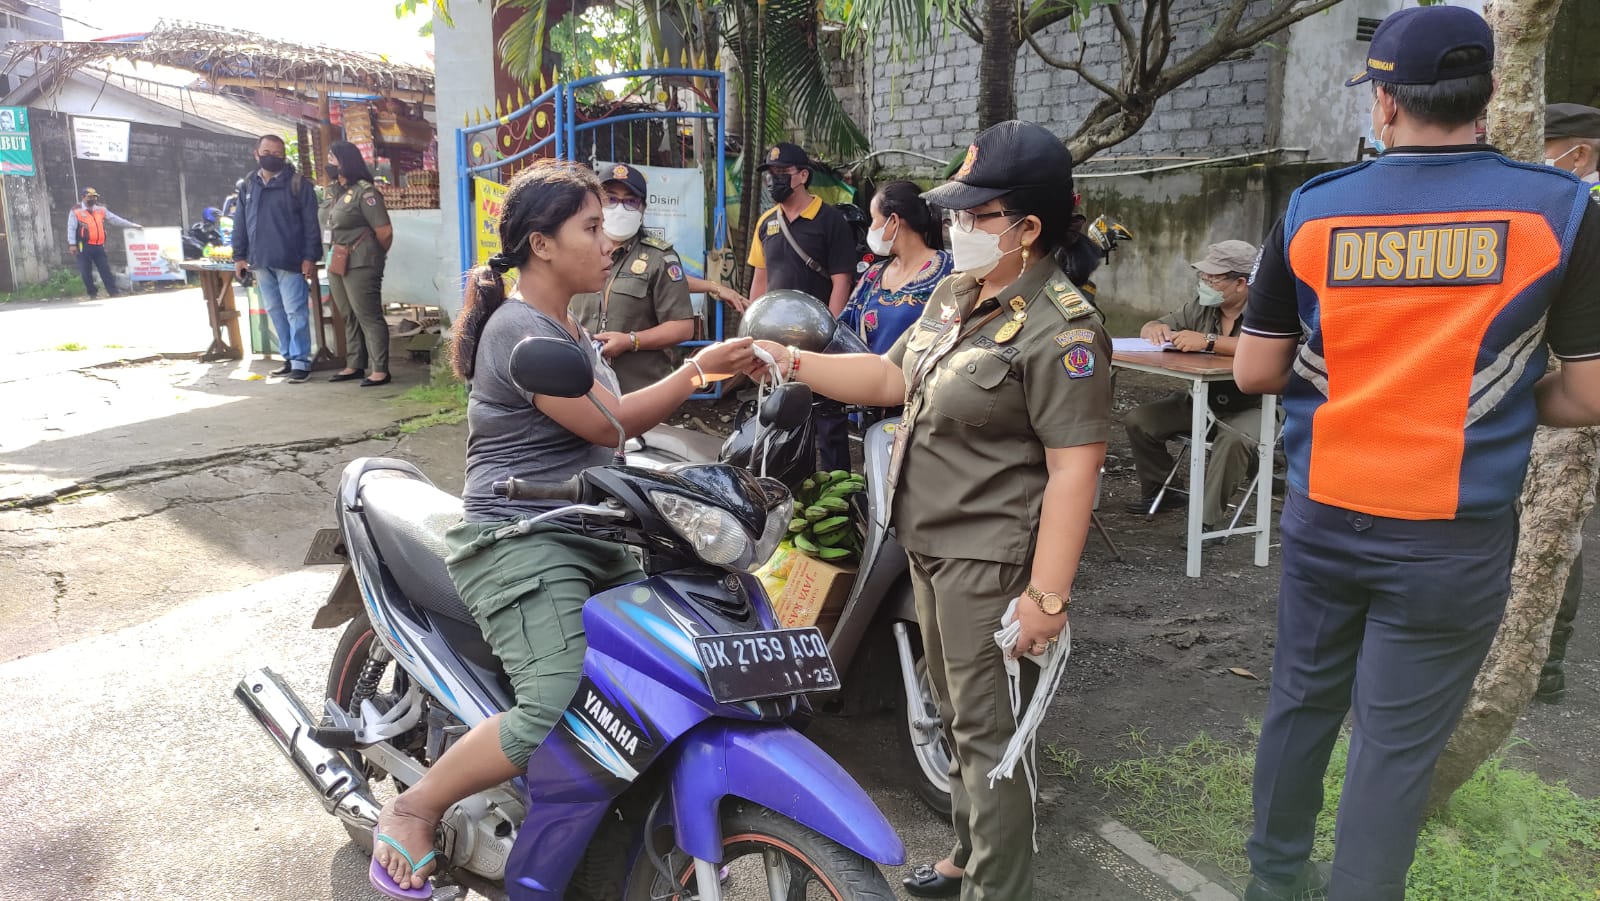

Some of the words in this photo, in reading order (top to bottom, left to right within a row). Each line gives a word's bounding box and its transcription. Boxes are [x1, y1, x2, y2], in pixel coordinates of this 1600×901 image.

[649, 194, 680, 206] Disini
[1333, 227, 1498, 281] DISHUB
[700, 641, 732, 669] DK
[733, 637, 786, 665] 2759
[584, 689, 639, 756] YAMAHA
